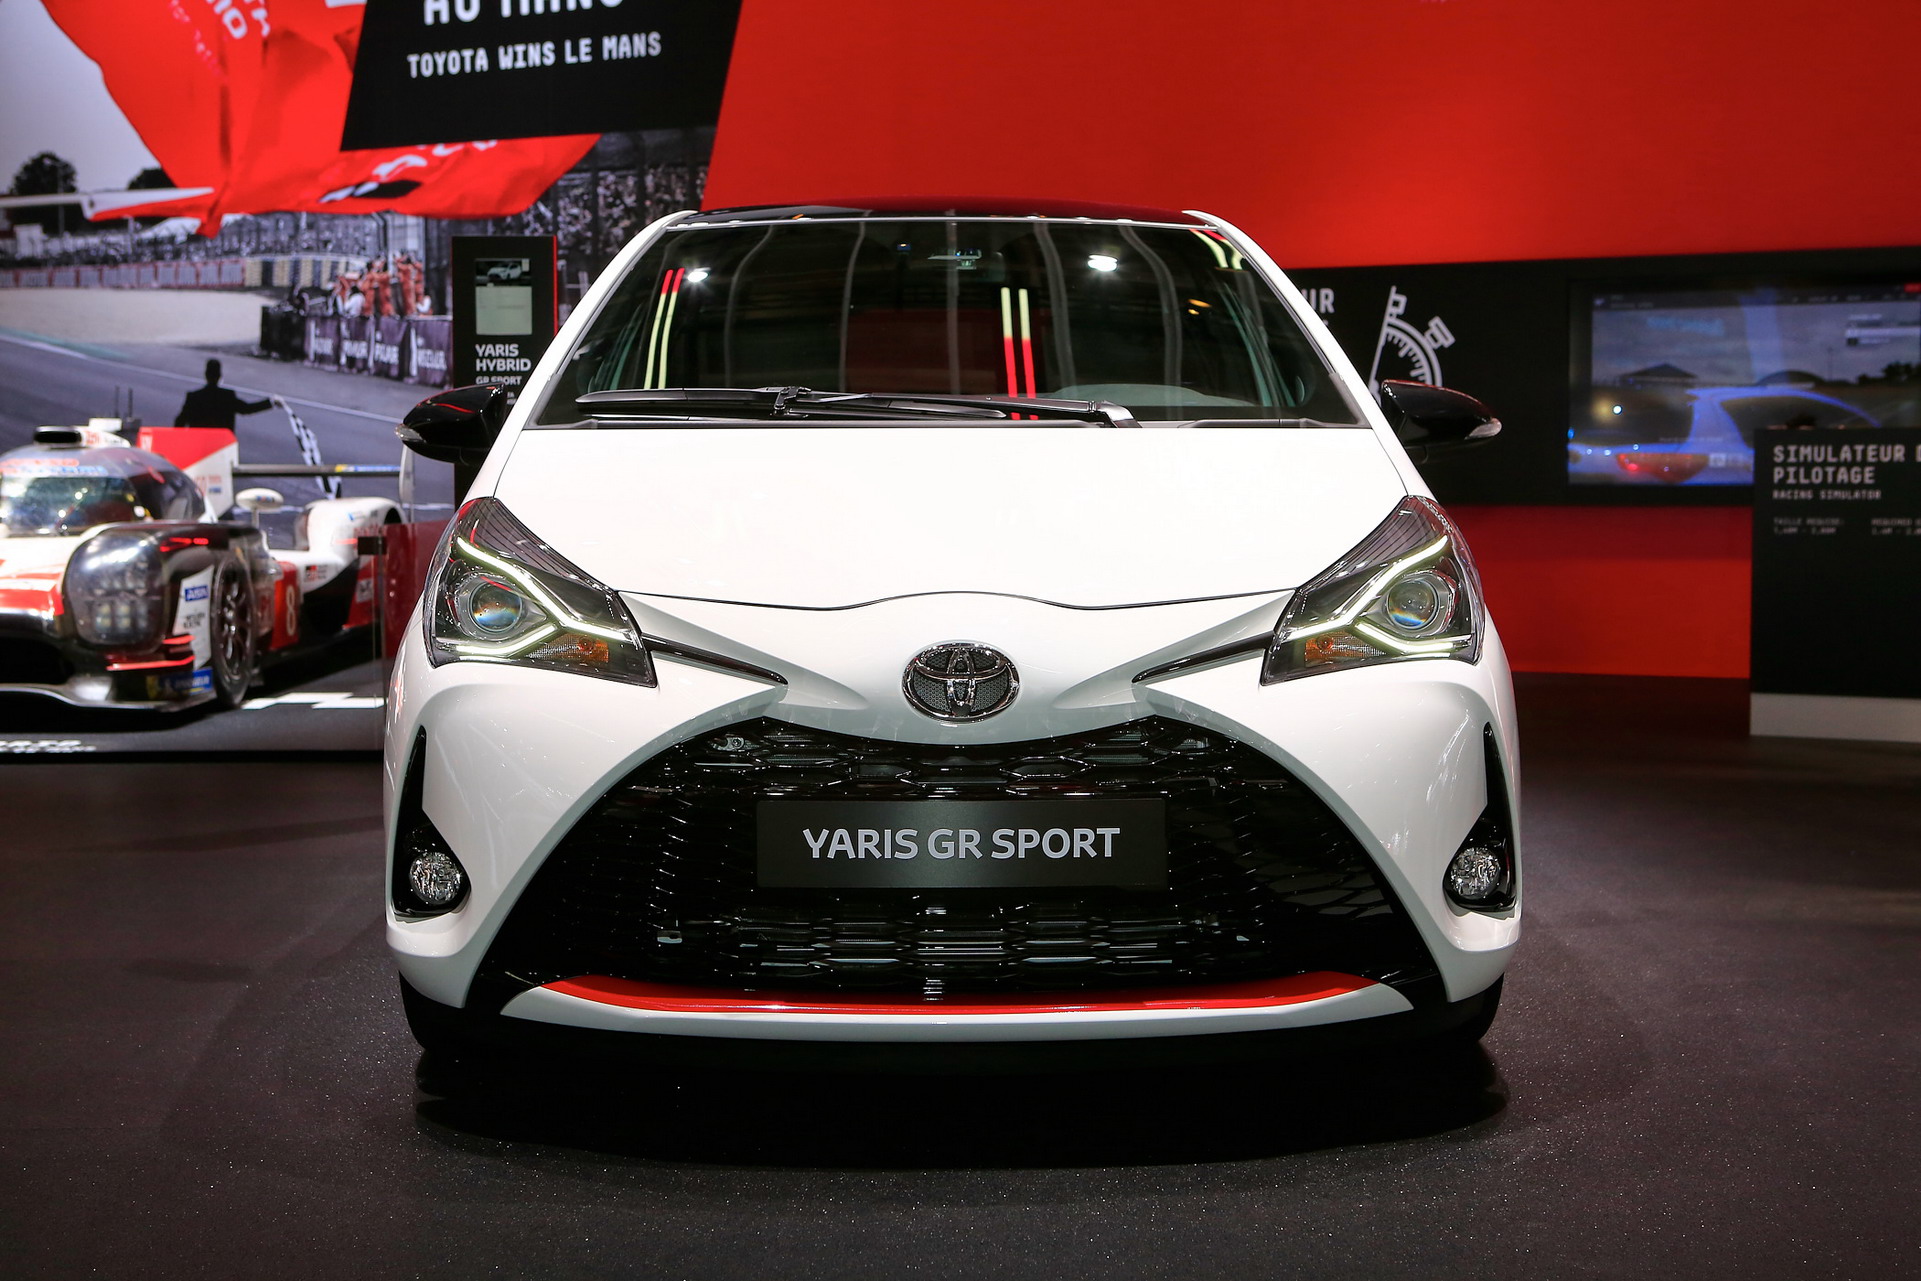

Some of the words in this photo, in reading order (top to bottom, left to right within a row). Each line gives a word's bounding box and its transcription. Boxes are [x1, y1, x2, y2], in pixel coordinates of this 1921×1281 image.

[406, 47, 489, 79] TOYOTA
[498, 40, 556, 70] WINS
[564, 38, 593, 65] LE
[602, 31, 662, 61] MANS
[475, 343, 519, 358] YARIS
[475, 358, 532, 372] HYBRID
[1773, 443, 1906, 463] SIMULATEUR
[1773, 466, 1876, 485] PILOTAGE
[1772, 489, 1814, 500] RACING
[1819, 489, 1882, 500] SIMULATOR
[285, 585, 297, 637] 8
[803, 828, 919, 860] YARIS
[927, 828, 983, 860] GR
[990, 827, 1121, 860] SPORT
